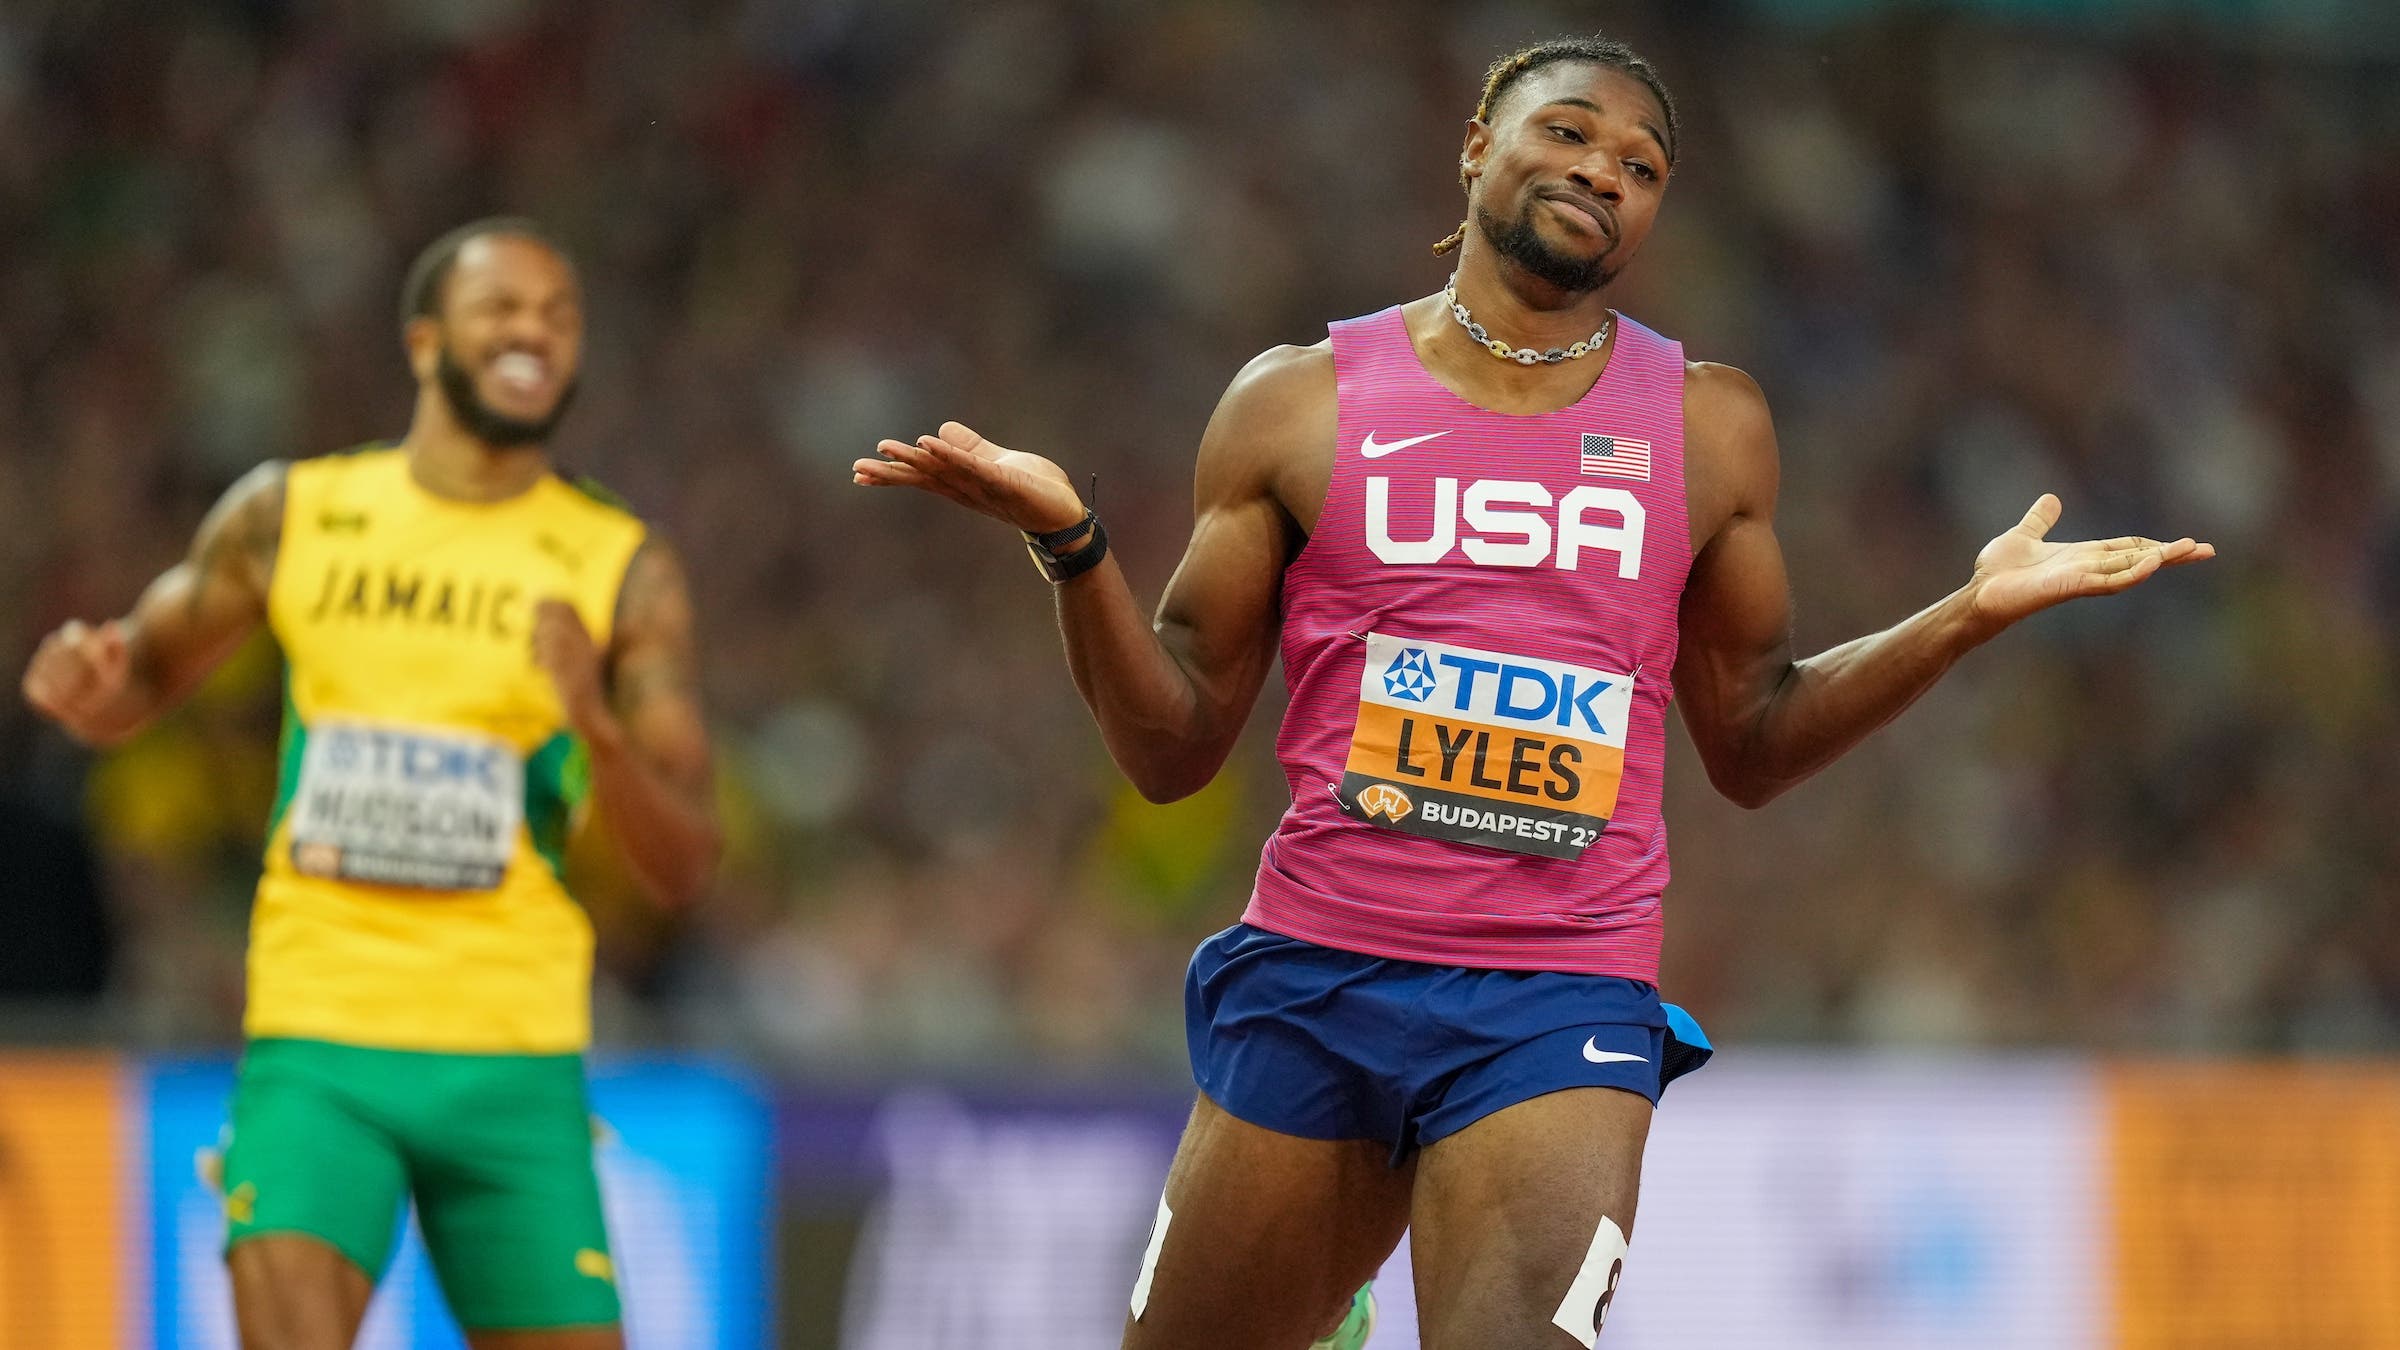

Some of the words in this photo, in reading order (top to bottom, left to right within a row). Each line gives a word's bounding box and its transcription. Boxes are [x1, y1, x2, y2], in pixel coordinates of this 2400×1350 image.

[1365, 476, 1646, 580] USA
[308, 558, 532, 638] JAMAIC
[1439, 653, 1613, 735] TDK
[369, 728, 500, 794] TDK
[1396, 718, 1582, 802] LYLES
[1421, 801, 1569, 844] BUDAPEST
